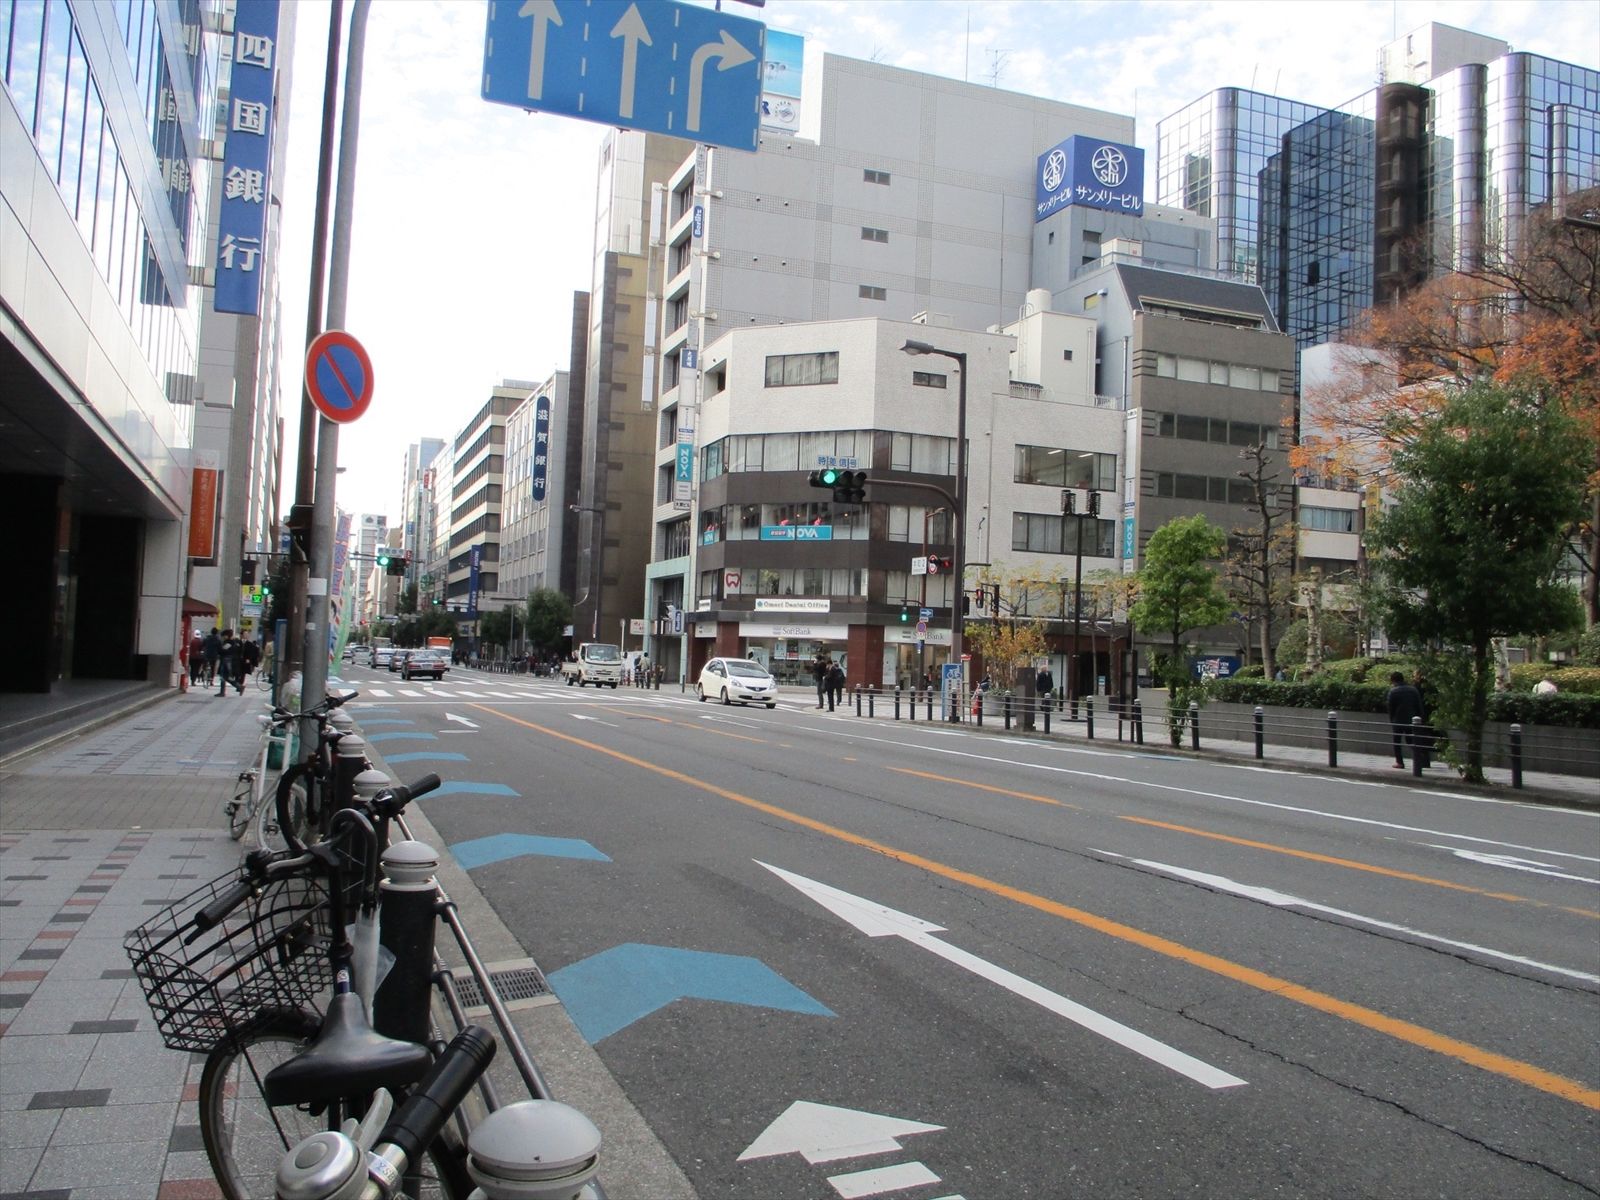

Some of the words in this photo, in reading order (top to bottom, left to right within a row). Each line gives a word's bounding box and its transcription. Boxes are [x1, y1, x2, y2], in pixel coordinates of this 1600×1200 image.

[220, 31, 273, 272] 四国銀行
[1037, 187, 1071, 215] サンメリービル
[1076, 185, 1142, 210] サンメリービル
[694, 208, 703, 236] Berlitz
[680, 448, 689, 477] NOVA
[787, 528, 818, 538] NOVA
[1126, 524, 1134, 555] NOVA
[783, 627, 811, 635] SoftBank
